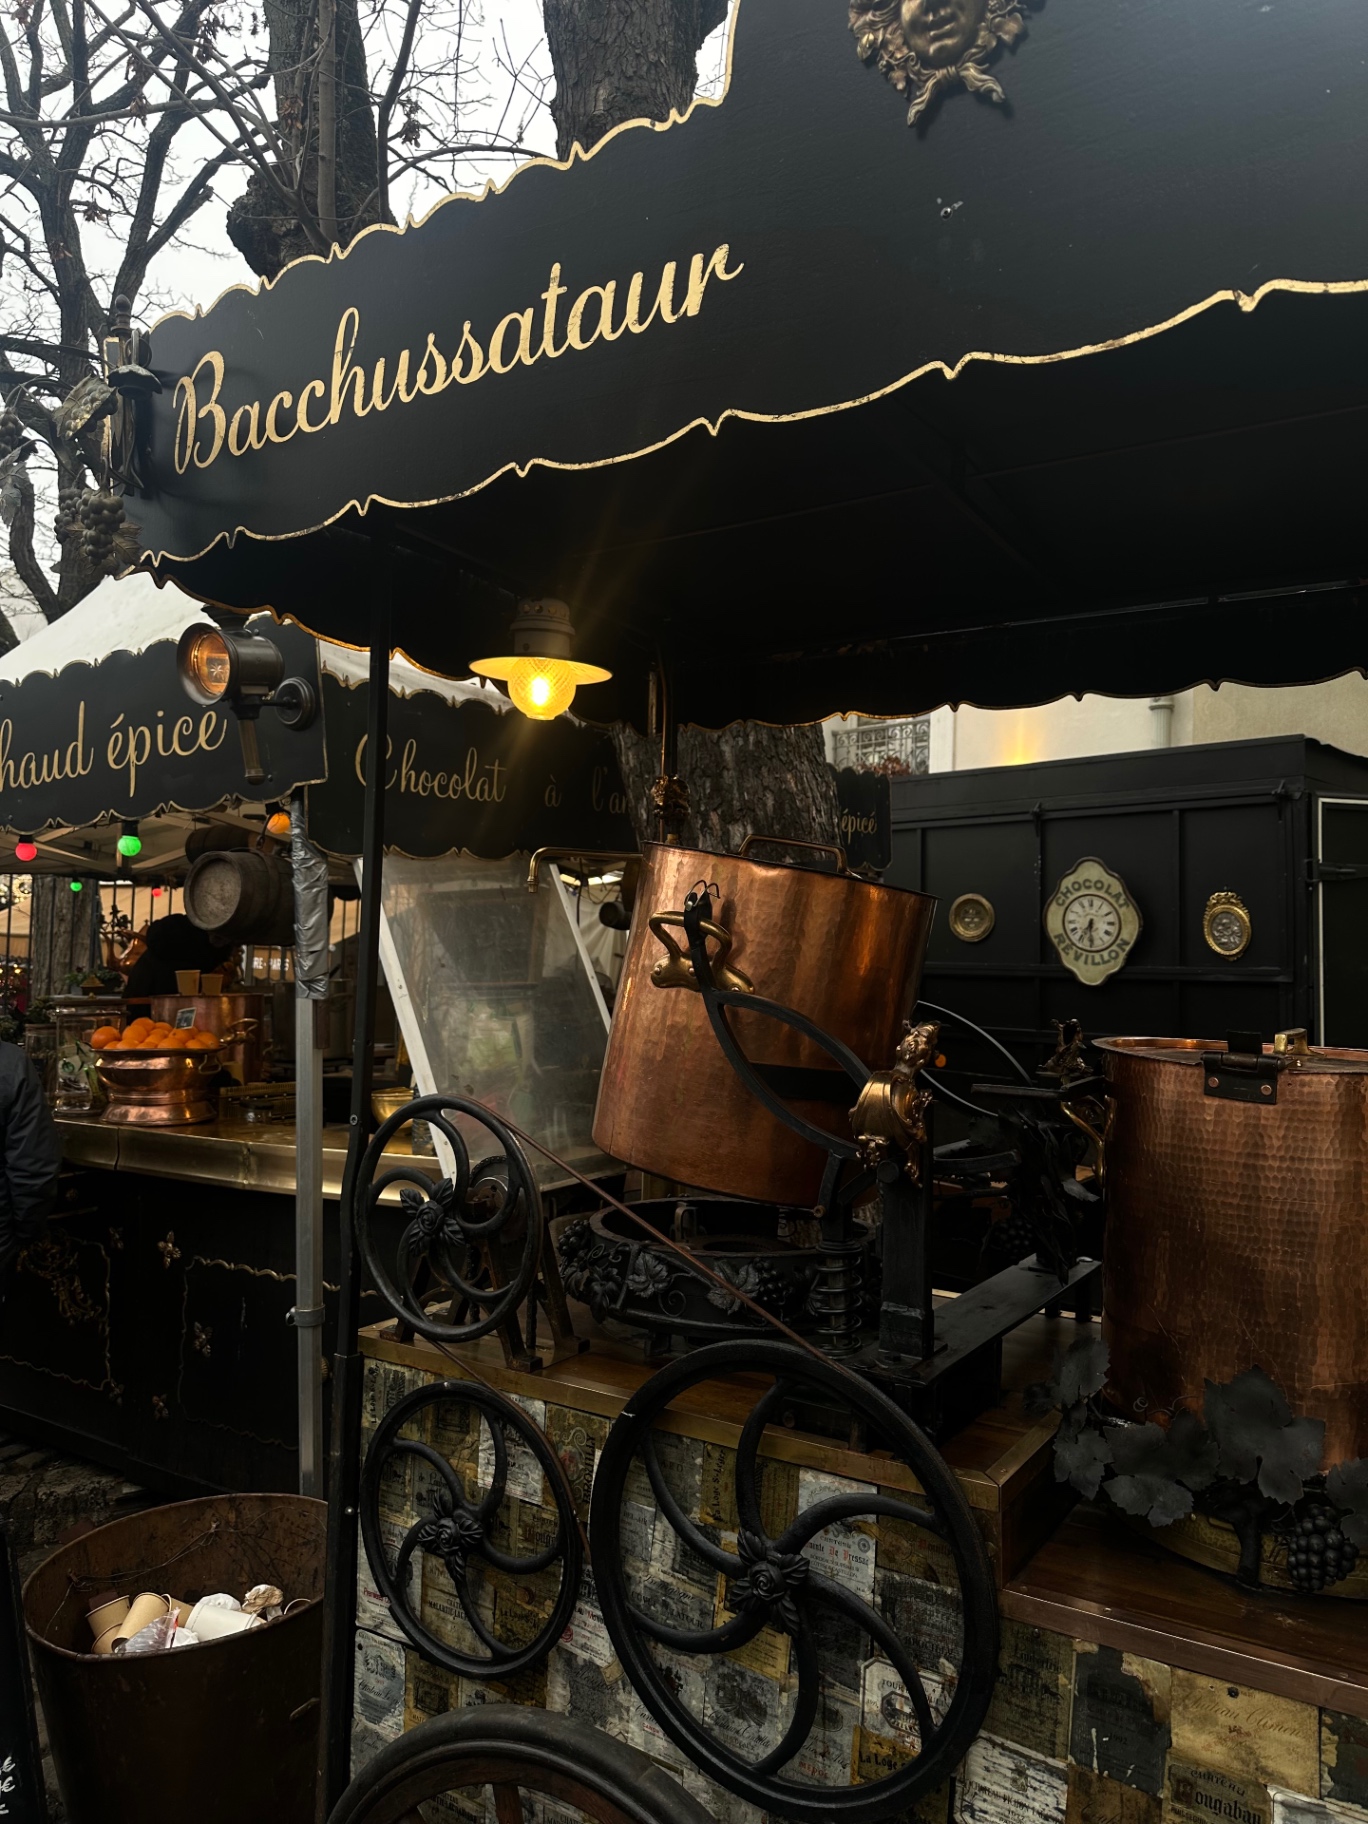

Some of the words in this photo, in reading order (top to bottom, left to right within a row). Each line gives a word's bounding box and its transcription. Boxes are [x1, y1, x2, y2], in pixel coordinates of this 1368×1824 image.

[173, 243, 744, 475] Bacchussataur
[0, 700, 94, 793] haud
[354, 732, 508, 802] Chocolat
[544, 774, 562, 808] à
[1055, 879, 1130, 909] CHOCOLAT
[581, 1432, 596, 1505] BROUILLY
[874, 1753, 898, 1771] Loge
